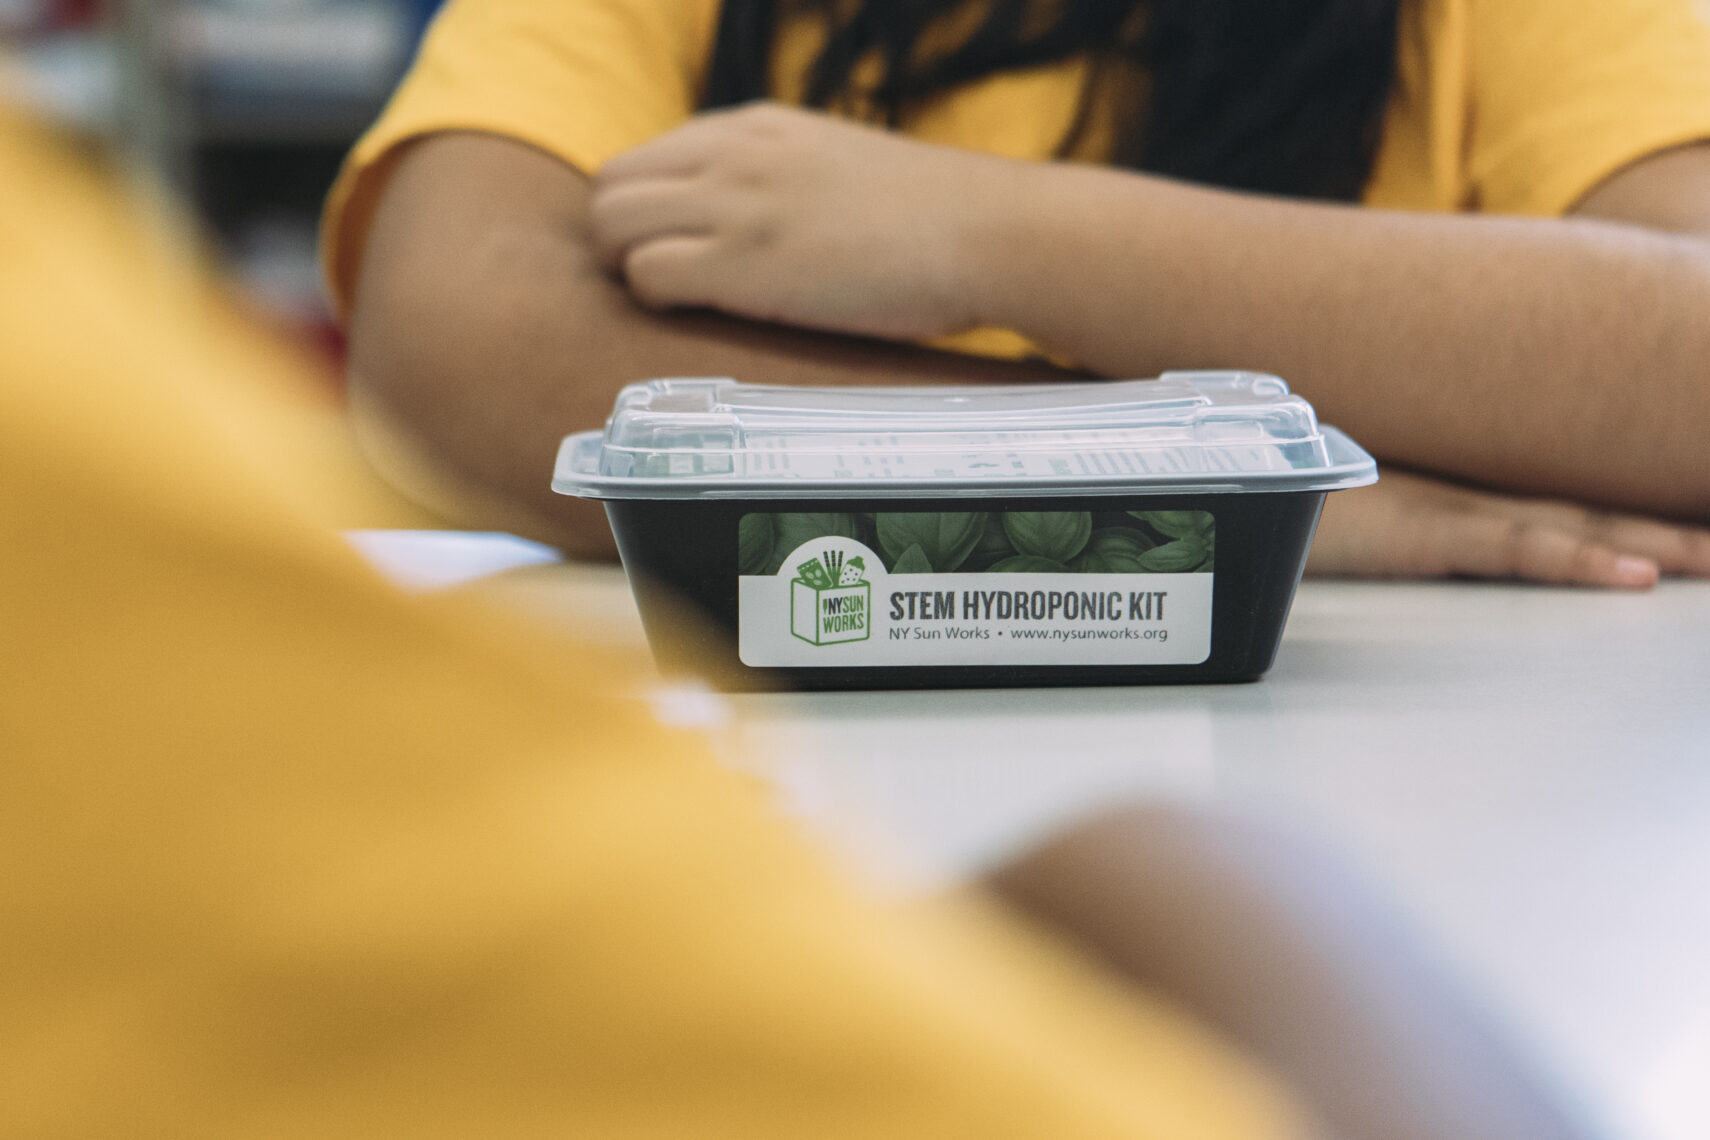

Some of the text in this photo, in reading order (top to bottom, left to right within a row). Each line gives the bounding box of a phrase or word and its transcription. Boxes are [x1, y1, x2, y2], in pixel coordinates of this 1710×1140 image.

[890, 590, 1167, 621] STEM HYDROPONIC KIT
[823, 613, 864, 634] WORKS
[889, 627, 1169, 643] NY Sun Works www.nysunworks.org
